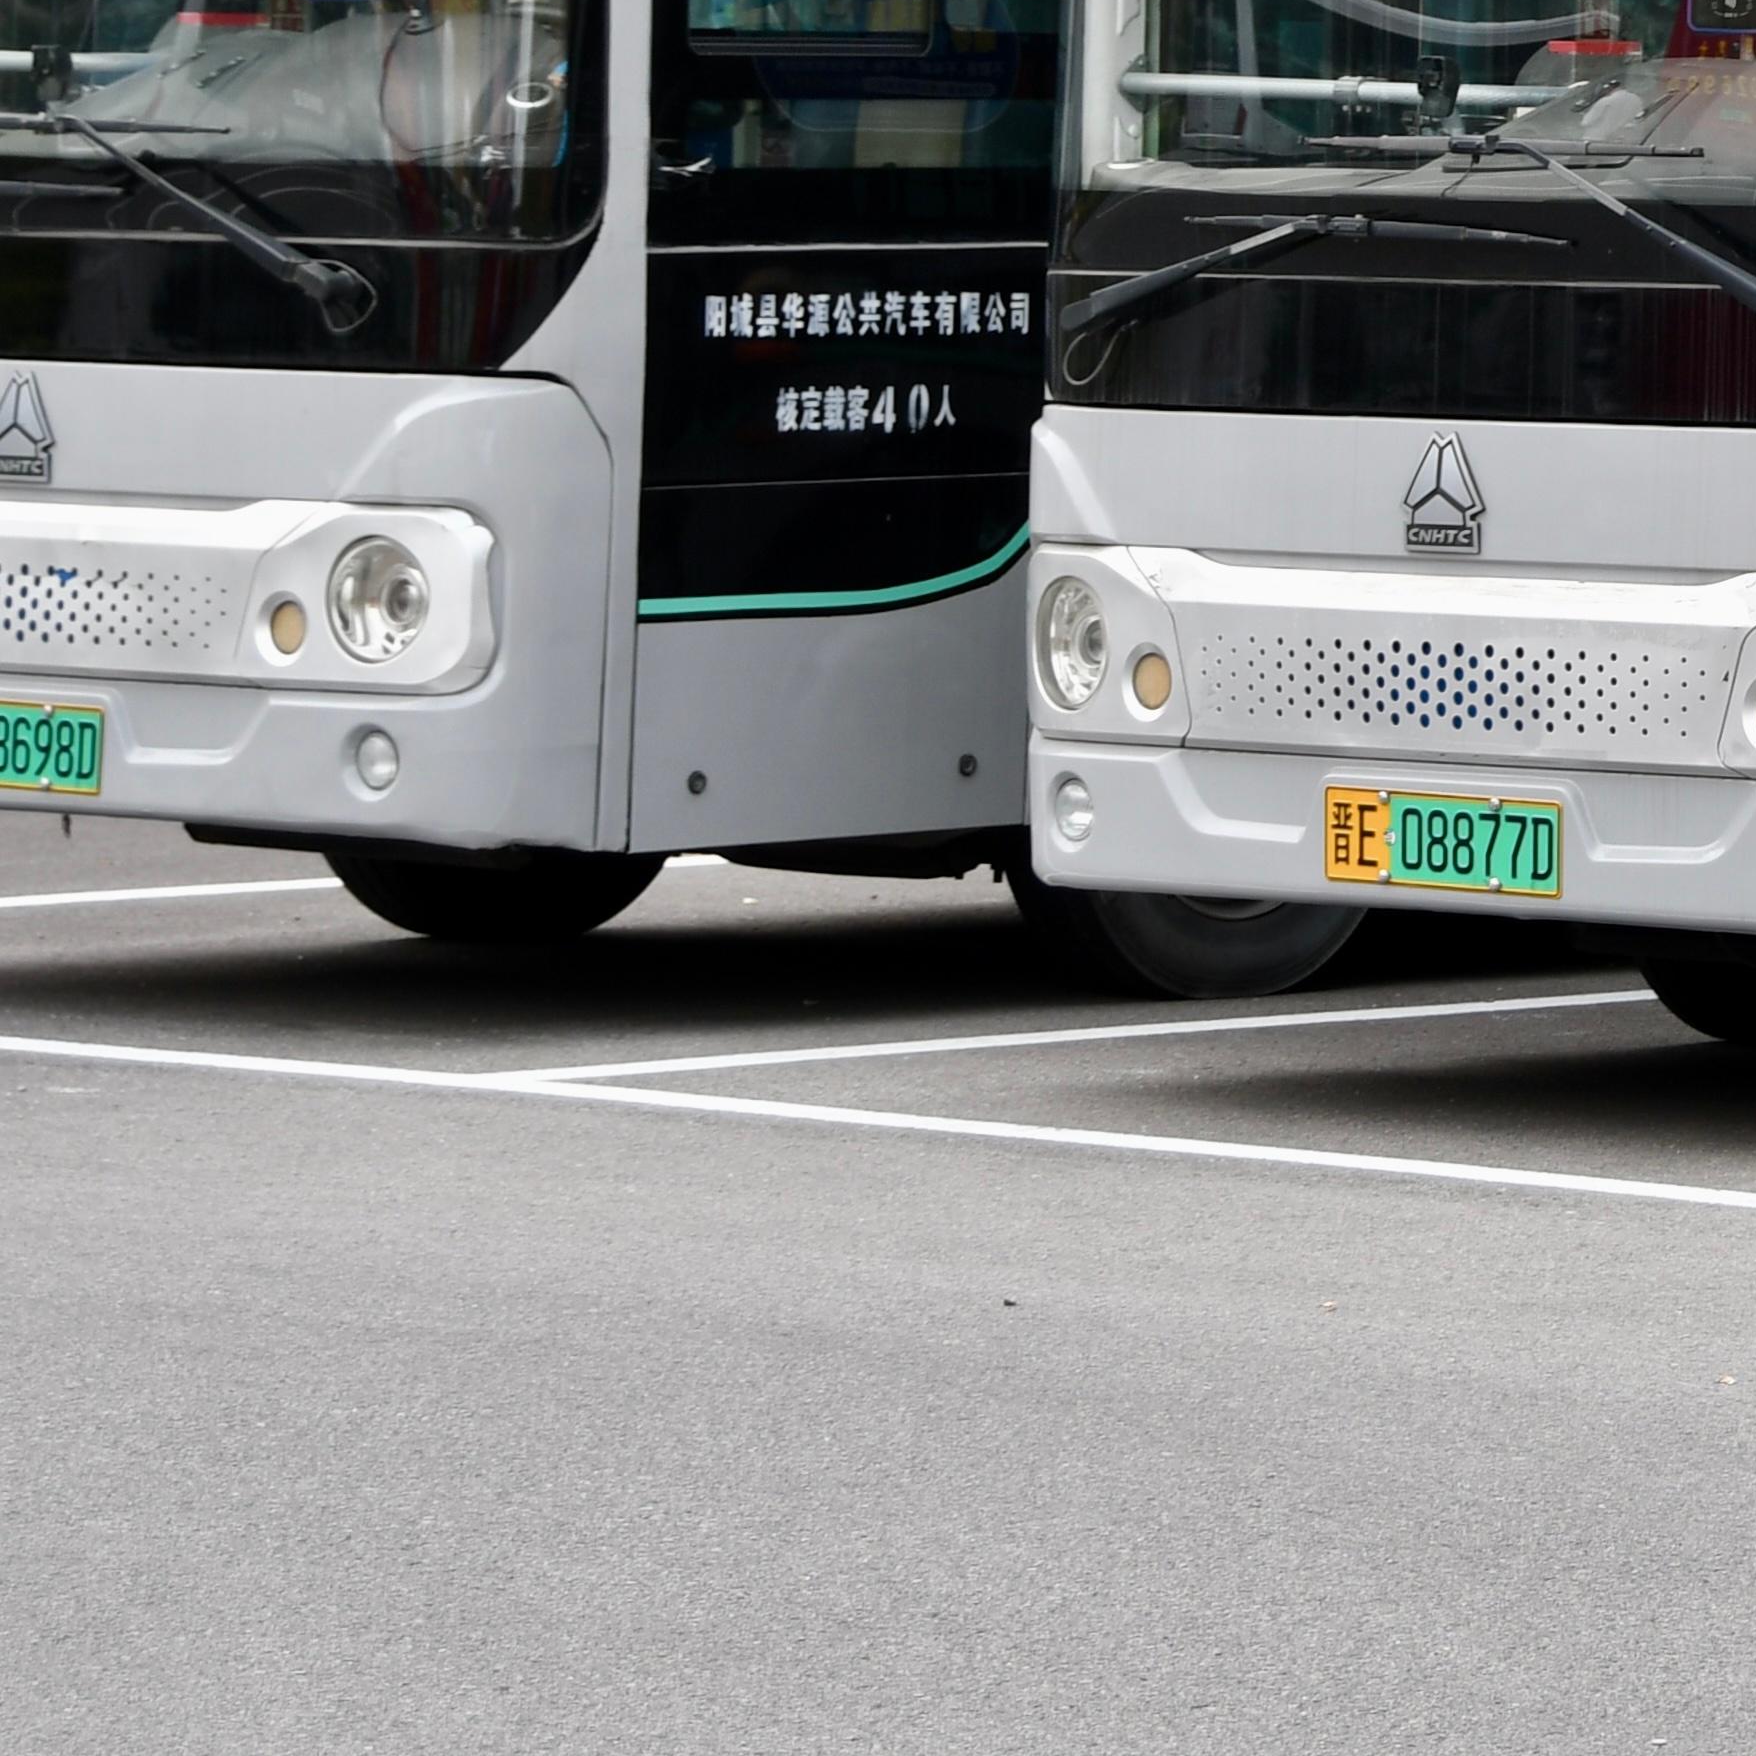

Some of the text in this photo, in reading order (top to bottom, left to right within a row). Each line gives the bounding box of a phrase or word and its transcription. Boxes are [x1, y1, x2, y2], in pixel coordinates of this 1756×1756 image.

[704, 290, 1030, 338] 阳城县华源公共汽车有限公司
[1407, 527, 1472, 544] CNHTC
